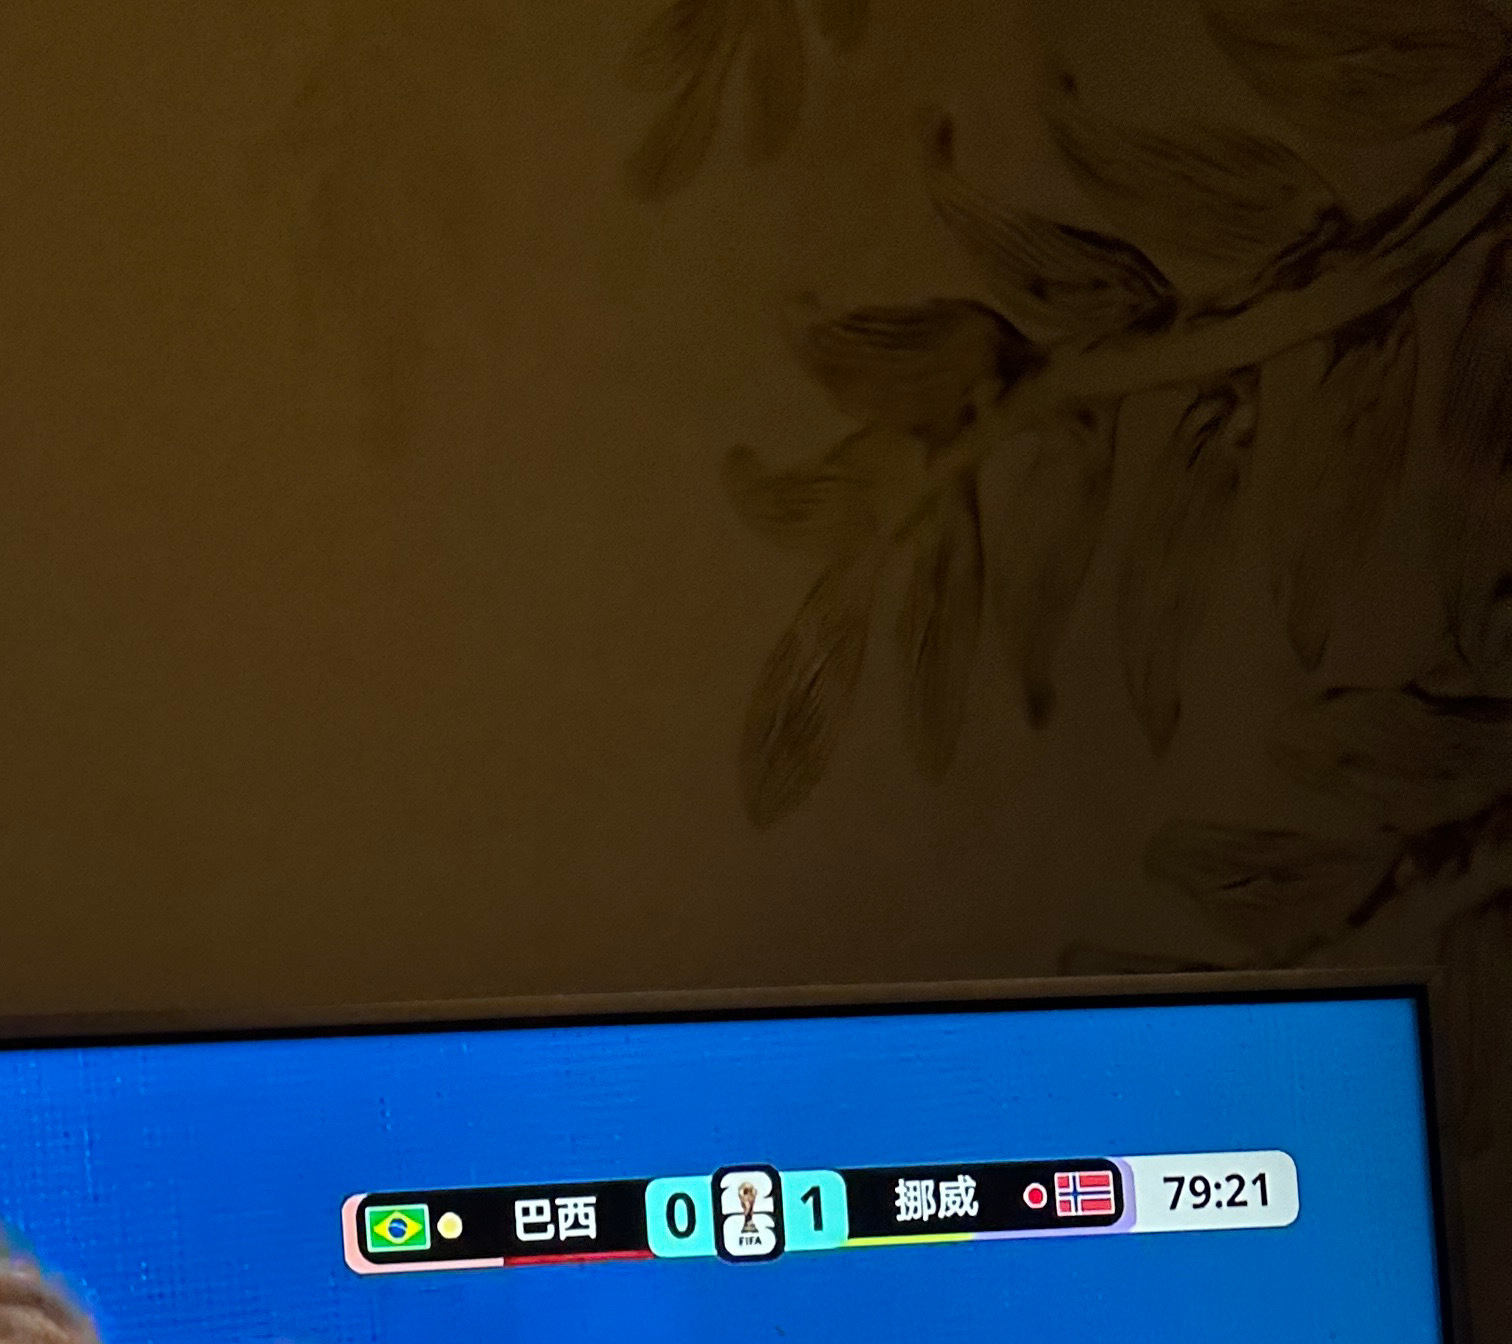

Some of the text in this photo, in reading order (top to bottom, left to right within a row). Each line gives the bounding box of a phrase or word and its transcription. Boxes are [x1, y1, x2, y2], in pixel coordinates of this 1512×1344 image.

[514, 1172, 1271, 1242] 巴西 0 1 挪威 79:21
[738, 1235, 763, 1247] FIFA
